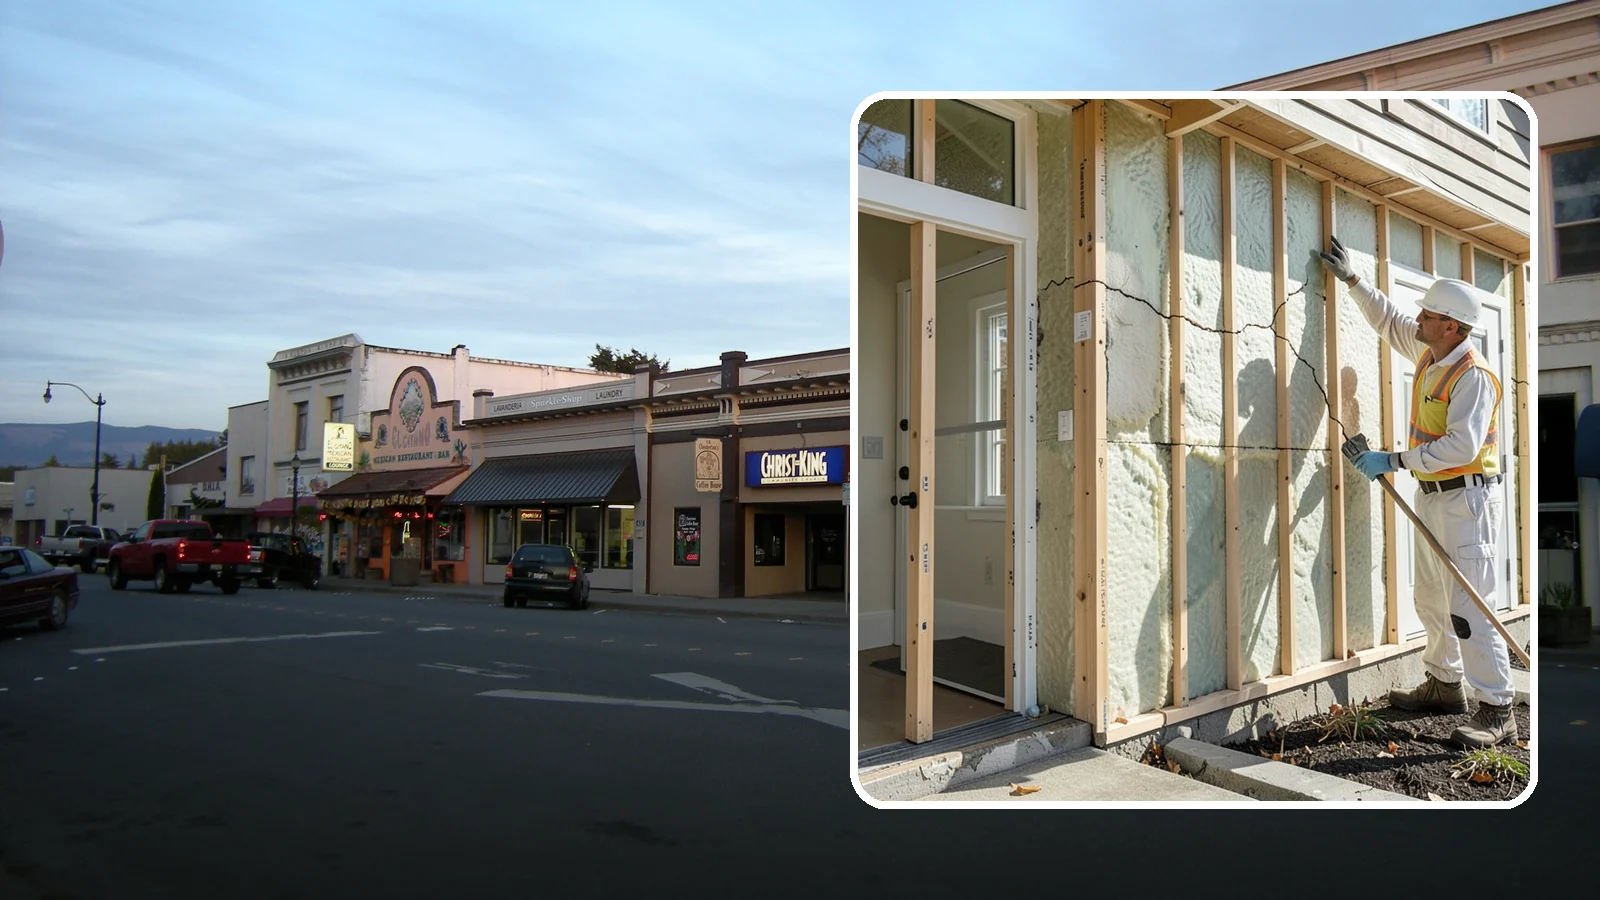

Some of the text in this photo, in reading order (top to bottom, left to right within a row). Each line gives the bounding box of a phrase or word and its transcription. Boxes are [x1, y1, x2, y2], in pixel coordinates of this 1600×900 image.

[494, 389, 624, 412] LAVANDERIA Sparkle Shop LAUNDRY
[373, 450, 450, 464] MEXICAN RESTAURANT BAR
[761, 450, 827, 478] CHRIST KING
